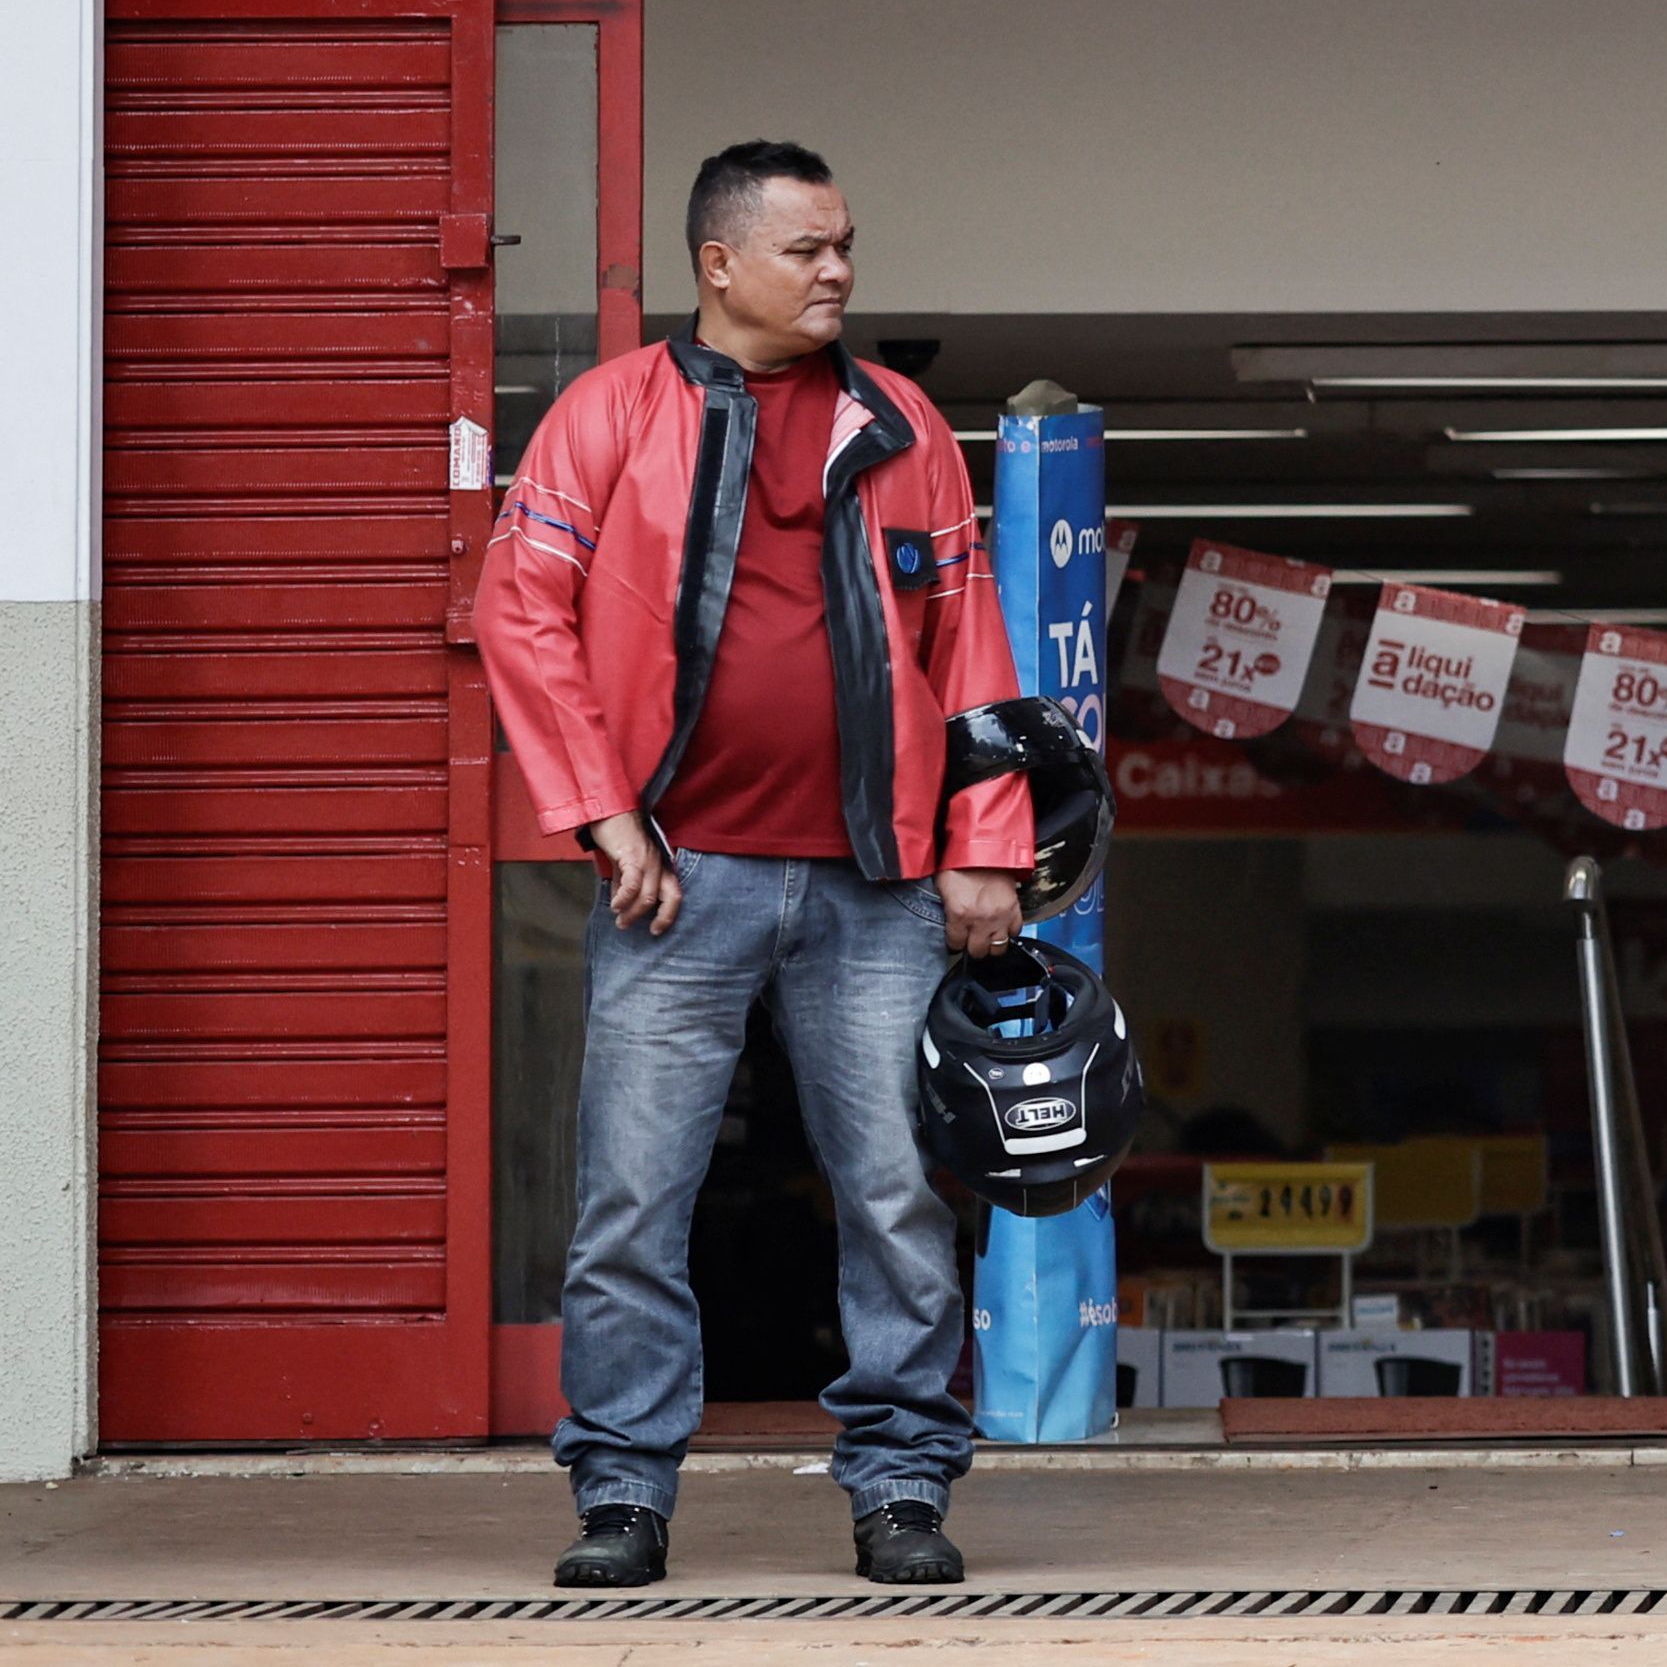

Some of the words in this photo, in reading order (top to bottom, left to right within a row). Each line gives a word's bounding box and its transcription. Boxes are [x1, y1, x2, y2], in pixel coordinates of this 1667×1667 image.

[1210, 590, 1281, 632] 80%
[1049, 600, 1099, 689] TÁ
[1198, 643, 1256, 683] 21x
[1407, 643, 1474, 680] liqui
[1401, 674, 1496, 712] dação
[1604, 730, 1662, 768] 21x
[1017, 1100, 1070, 1125] HELT
